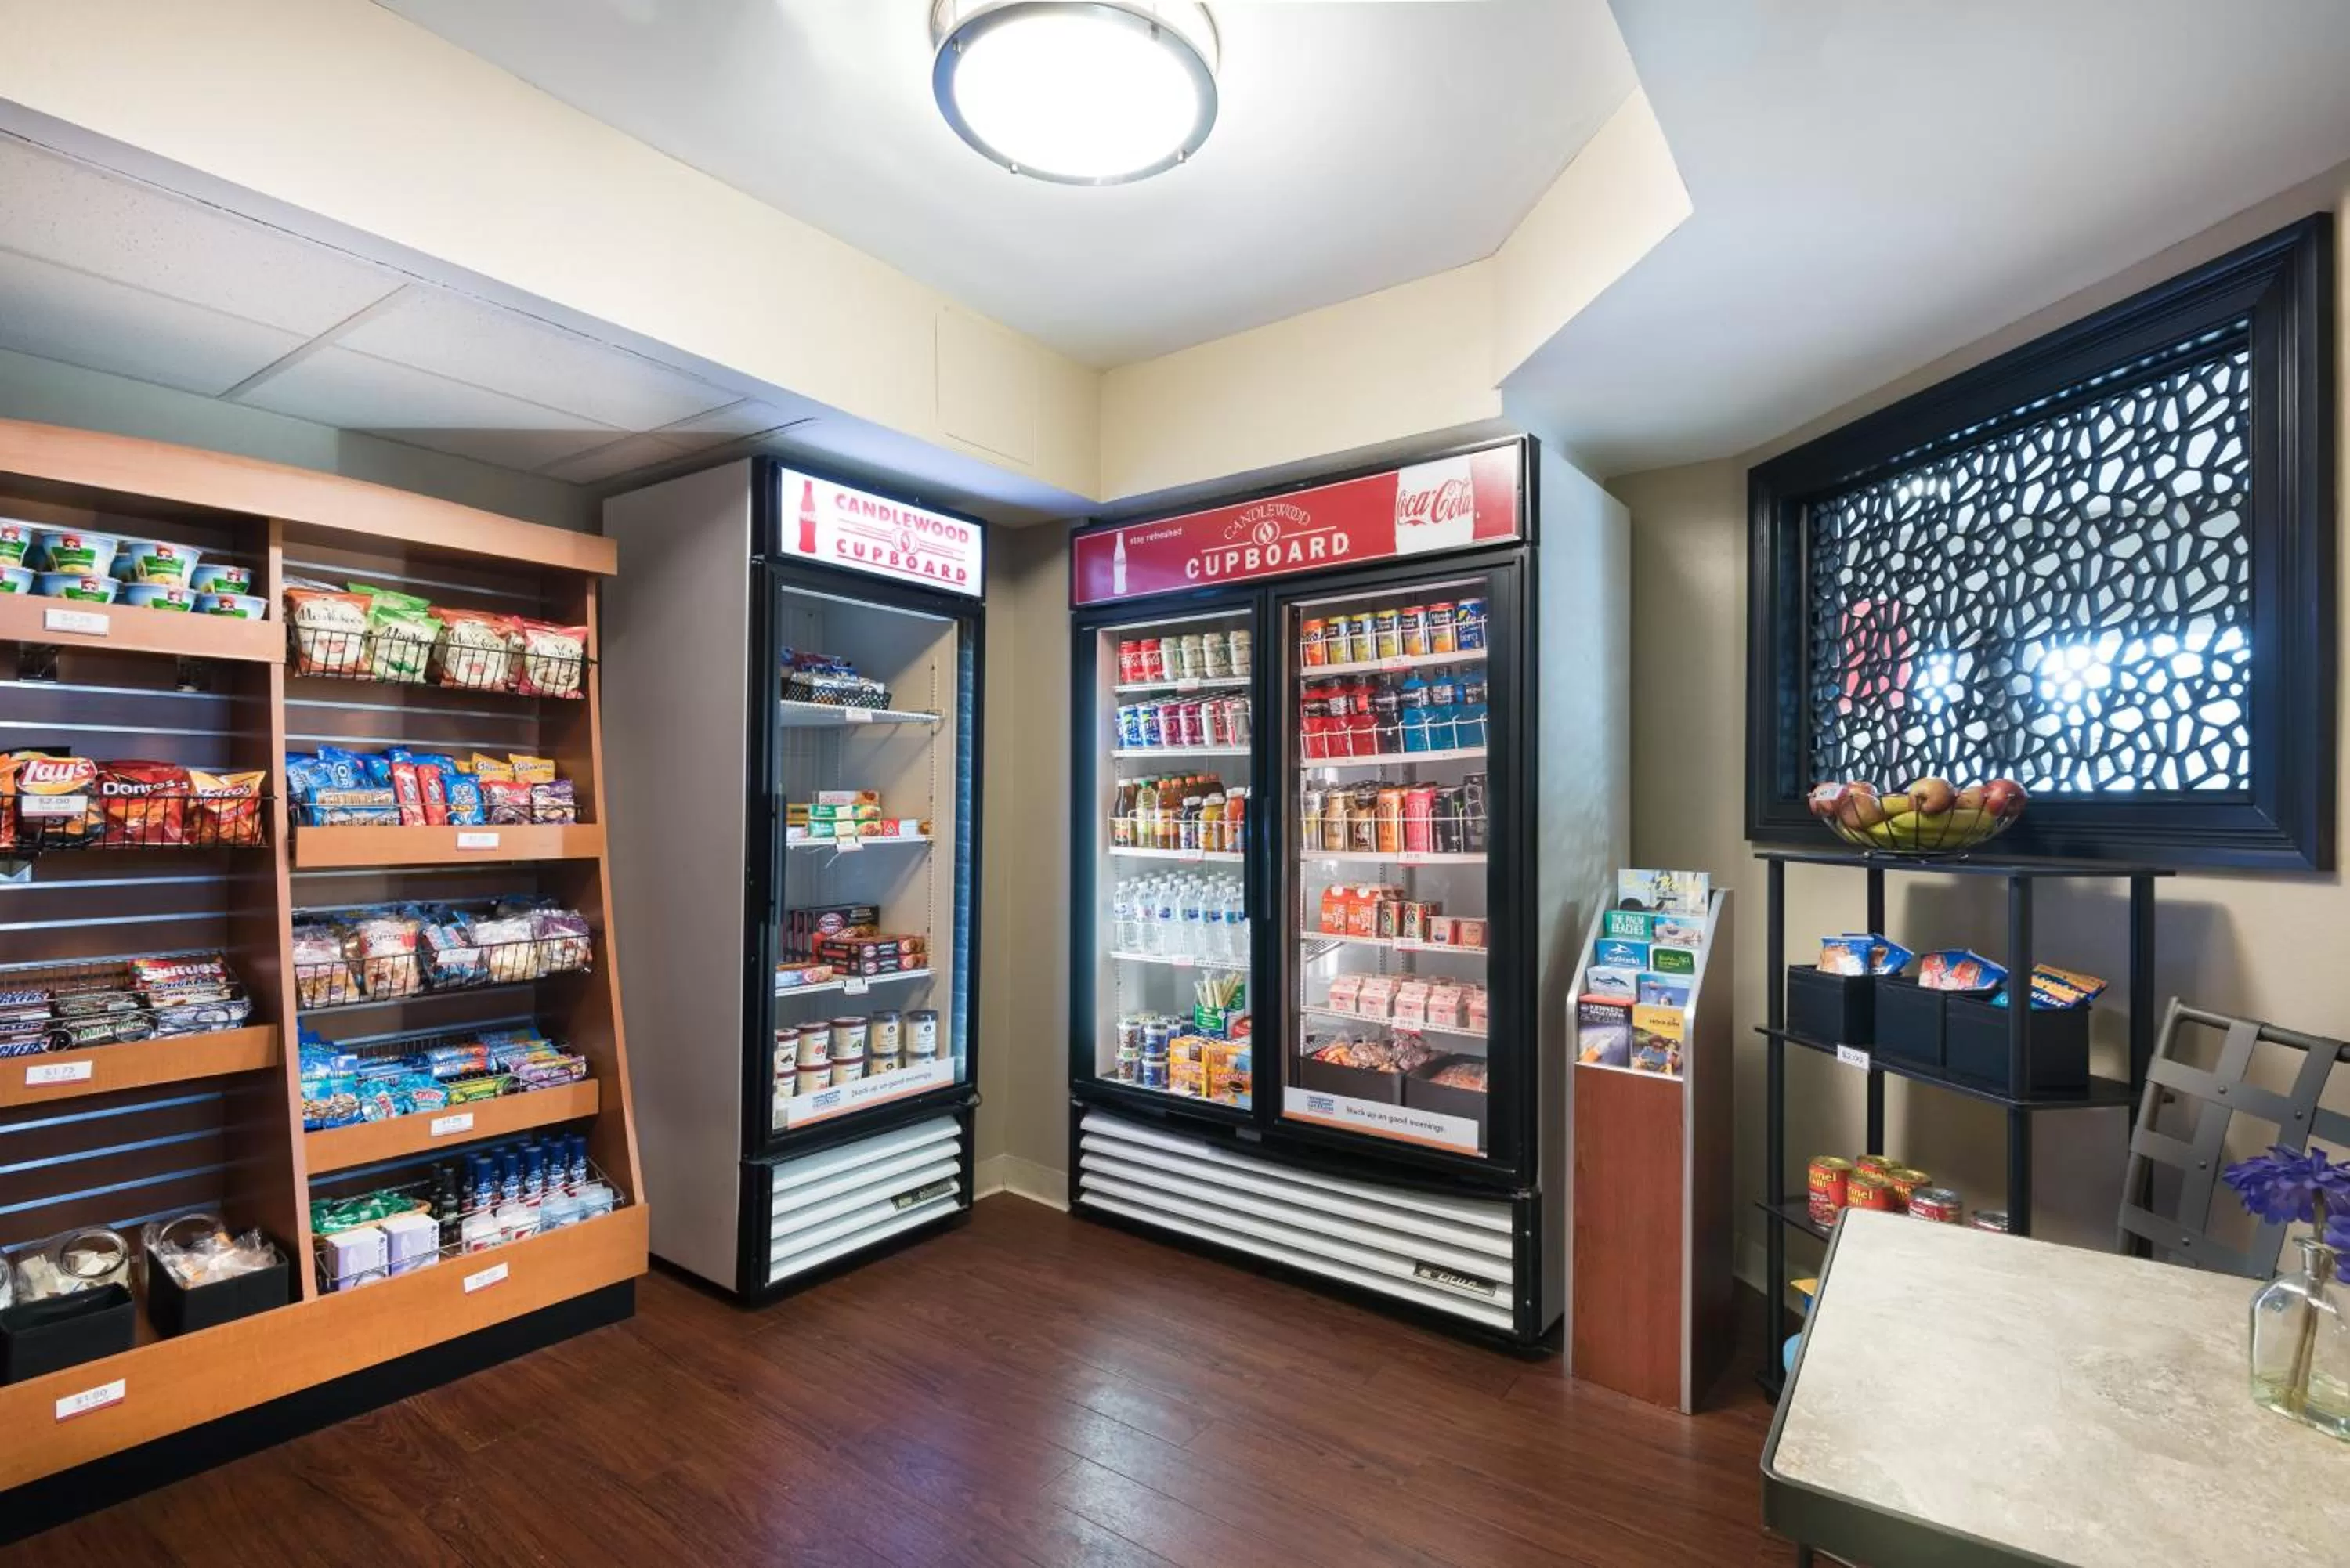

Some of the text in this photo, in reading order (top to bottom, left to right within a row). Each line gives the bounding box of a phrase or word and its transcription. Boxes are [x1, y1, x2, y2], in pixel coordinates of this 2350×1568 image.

[835, 493, 970, 544] CANDLEWOOD
[1223, 503, 1311, 540] CANDLEWOOD
[836, 537, 967, 582] CUPBOARD
[1185, 532, 1350, 580] CUPBOARD
[22, 760, 90, 786] Lay's
[103, 779, 175, 794] Doritos
[1604, 953, 1640, 965] SeaWorld
